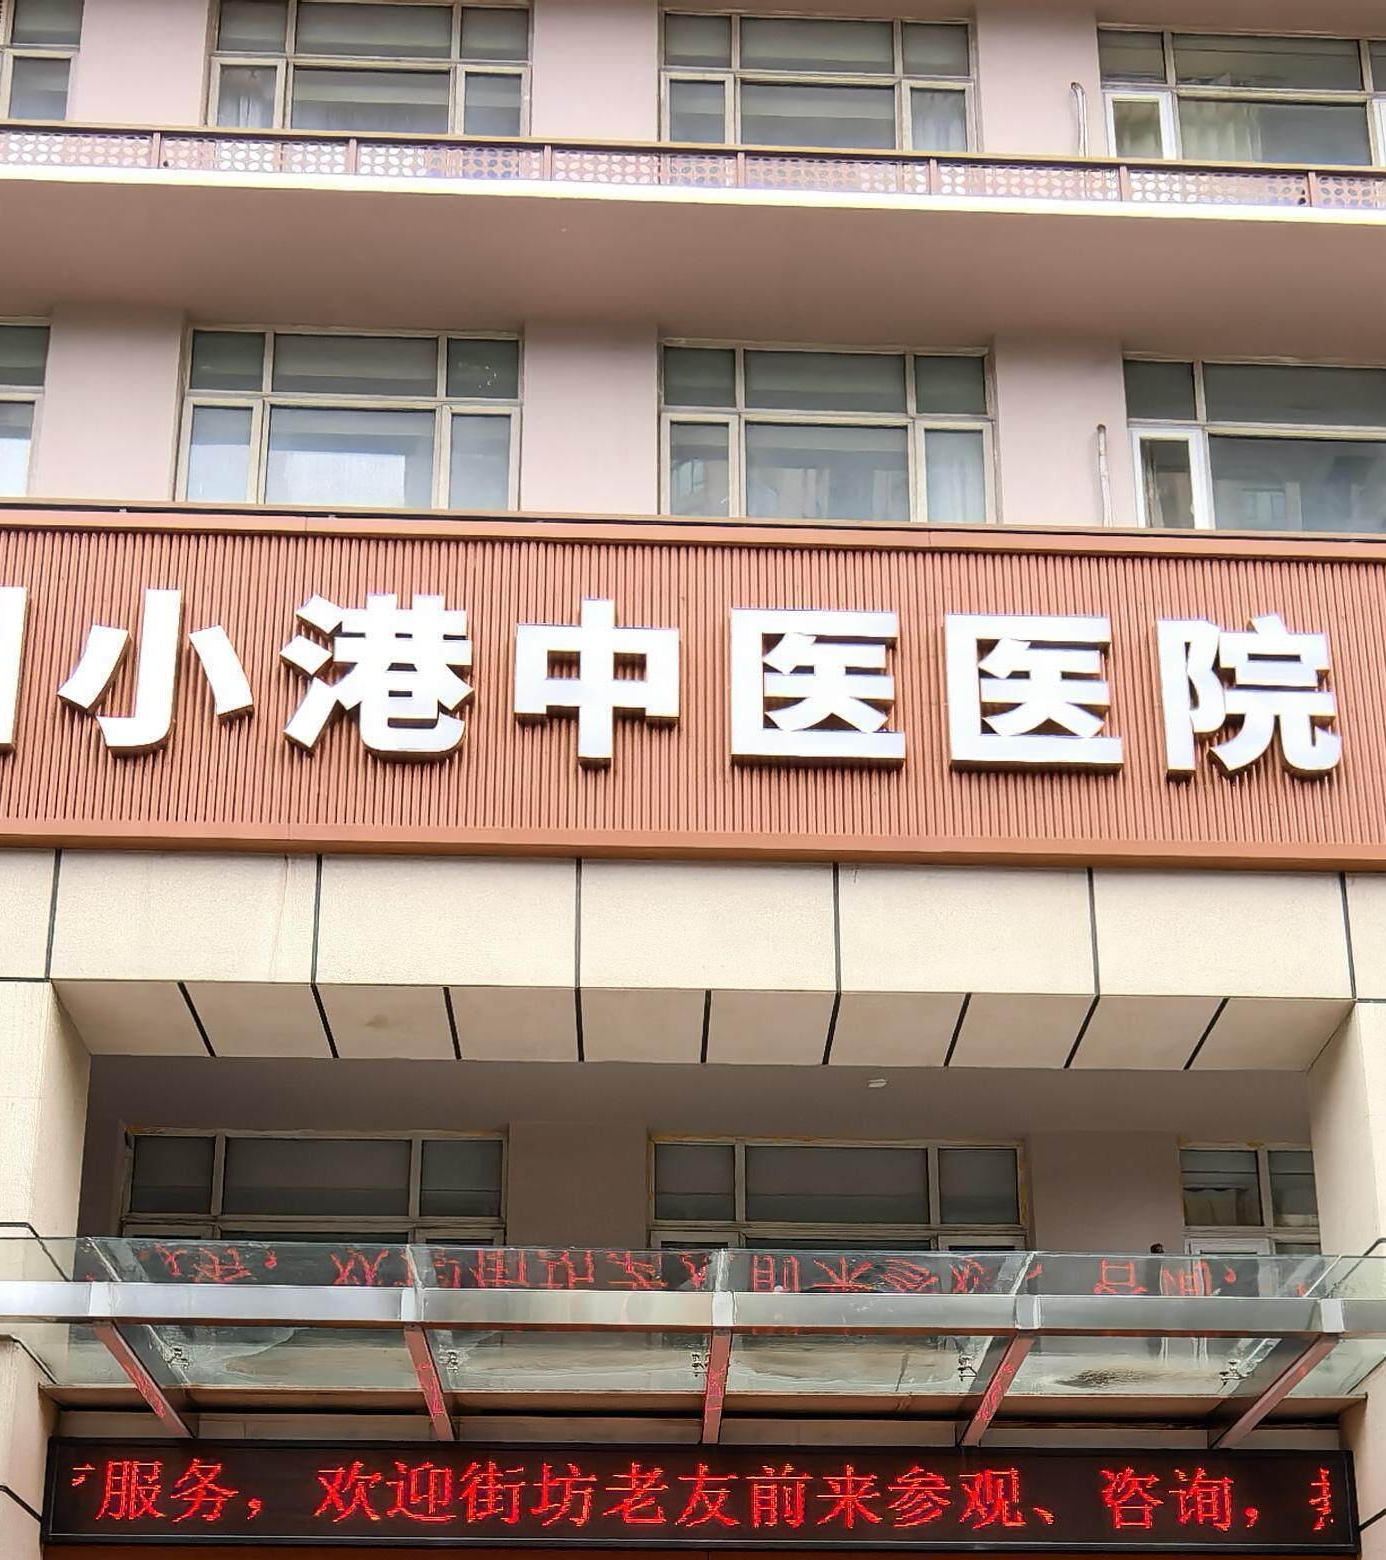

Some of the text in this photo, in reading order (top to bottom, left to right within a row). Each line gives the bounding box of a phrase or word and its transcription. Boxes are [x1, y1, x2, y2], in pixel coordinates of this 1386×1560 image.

[71, 1456, 1335, 1532] 服务，欢迎街坊老友前来参观、咨询，
